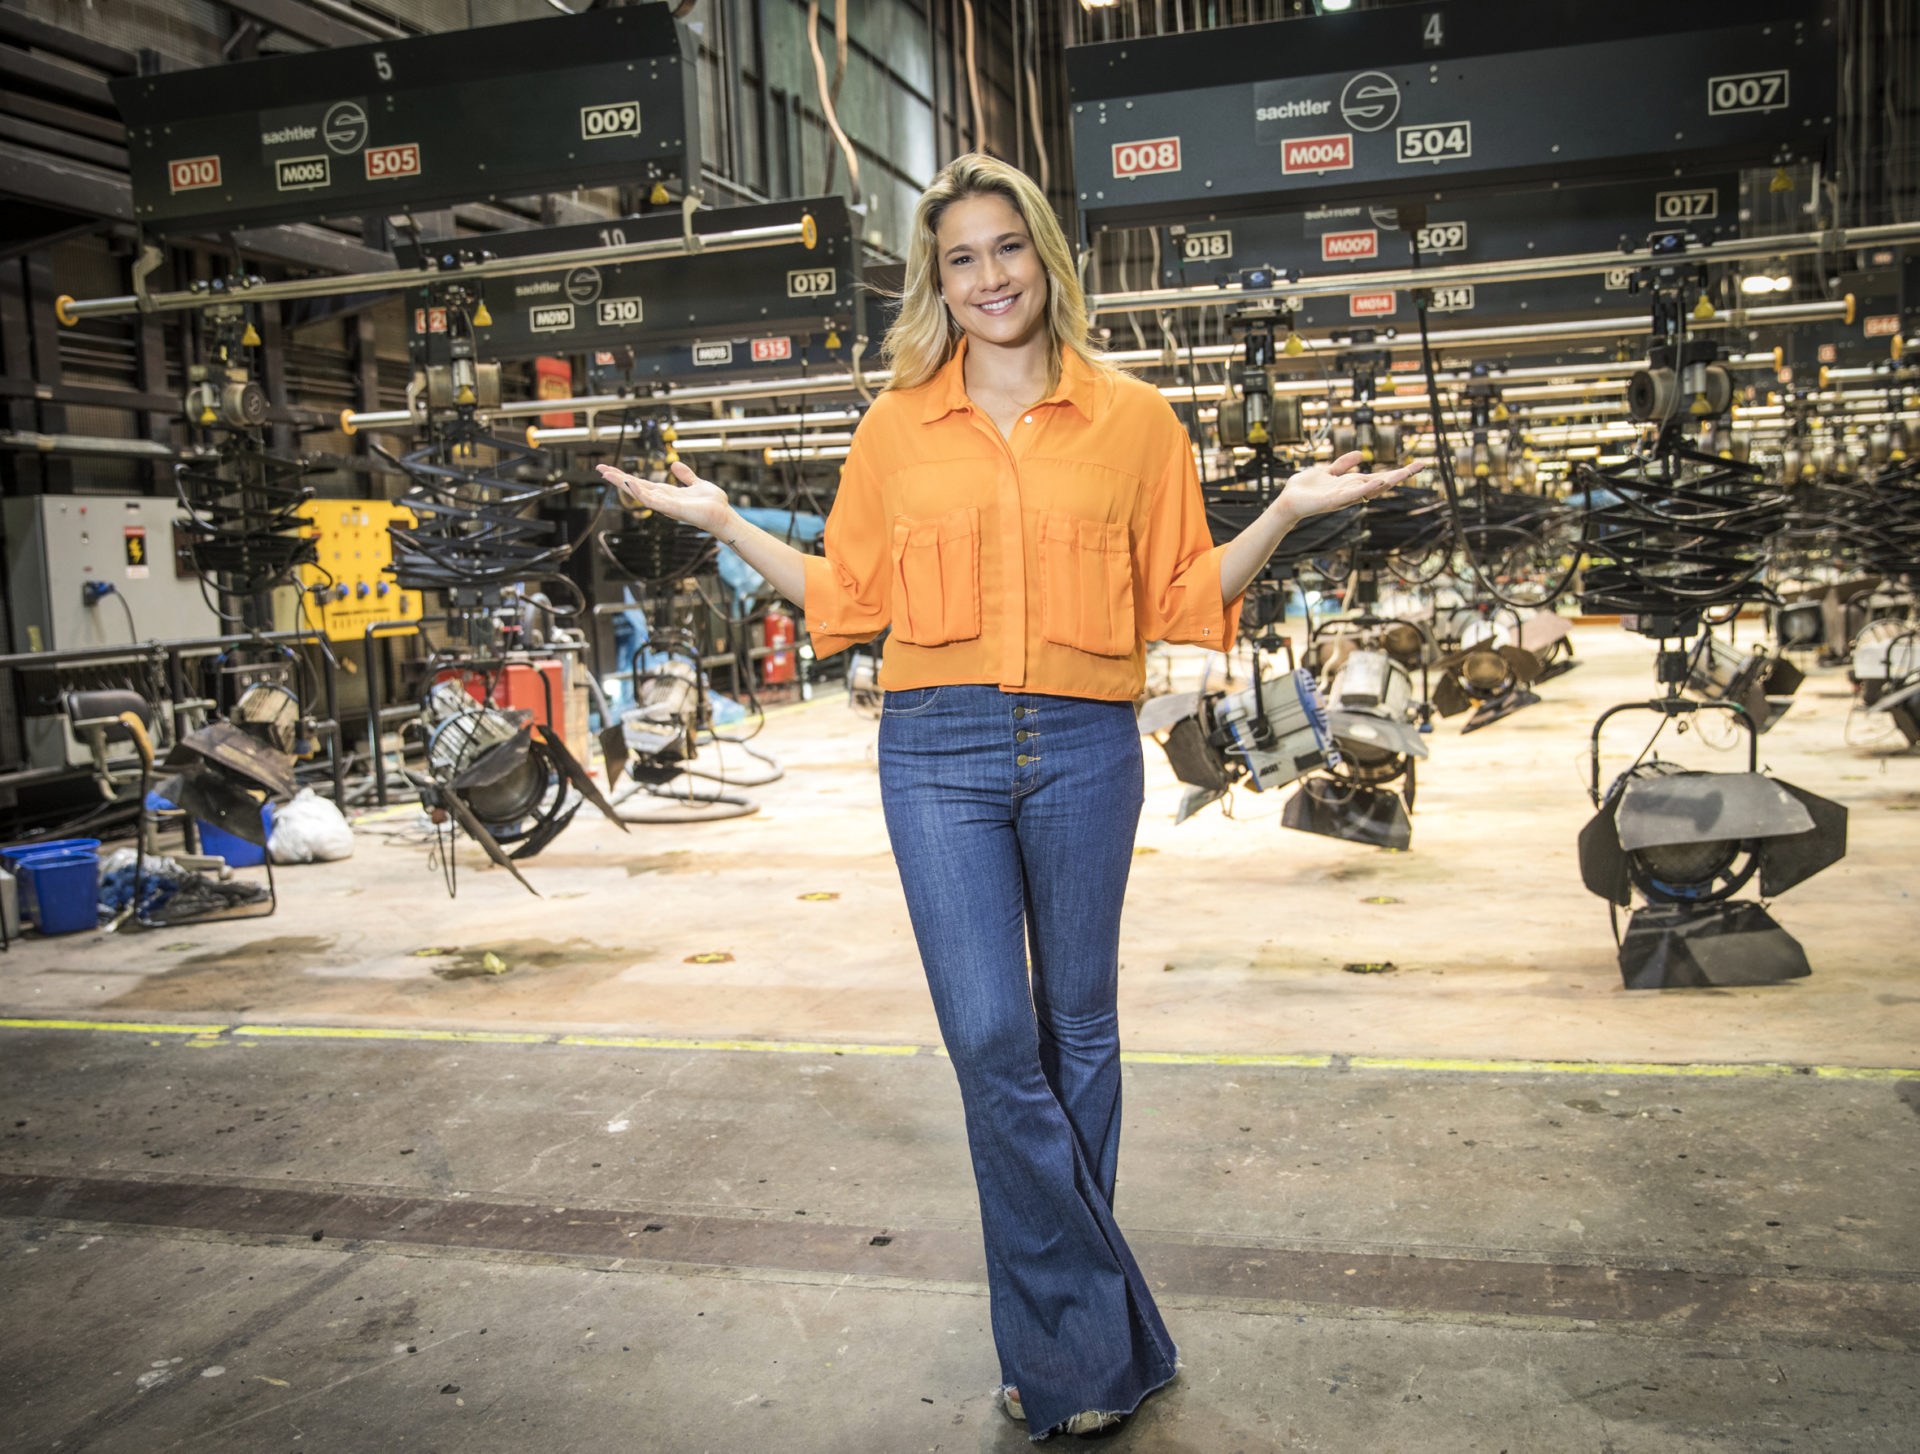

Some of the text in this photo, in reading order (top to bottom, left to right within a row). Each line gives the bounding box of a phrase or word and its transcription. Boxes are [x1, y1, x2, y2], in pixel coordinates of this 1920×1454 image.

[1424, 12, 1444, 46] 4
[374, 52, 393, 80] 5
[1716, 77, 1782, 109] 007
[586, 108, 635, 135] 009
[1256, 99, 1331, 122] sachtler
[262, 124, 317, 145] sachtler
[1404, 126, 1466, 157] 504
[371, 149, 416, 175] 505
[1118, 143, 1176, 172] 008
[1289, 142, 1346, 166] M004
[176, 162, 215, 186] 010
[283, 163, 325, 184] M005
[1665, 195, 1708, 216] 017
[599, 228, 627, 248] 10
[1184, 235, 1226, 258] 018
[1328, 236, 1372, 255] M009
[1417, 226, 1462, 250] 509
[793, 273, 830, 293] 019
[1433, 289, 1468, 308] 514
[603, 301, 637, 321] 510
[758, 342, 786, 358] 515
